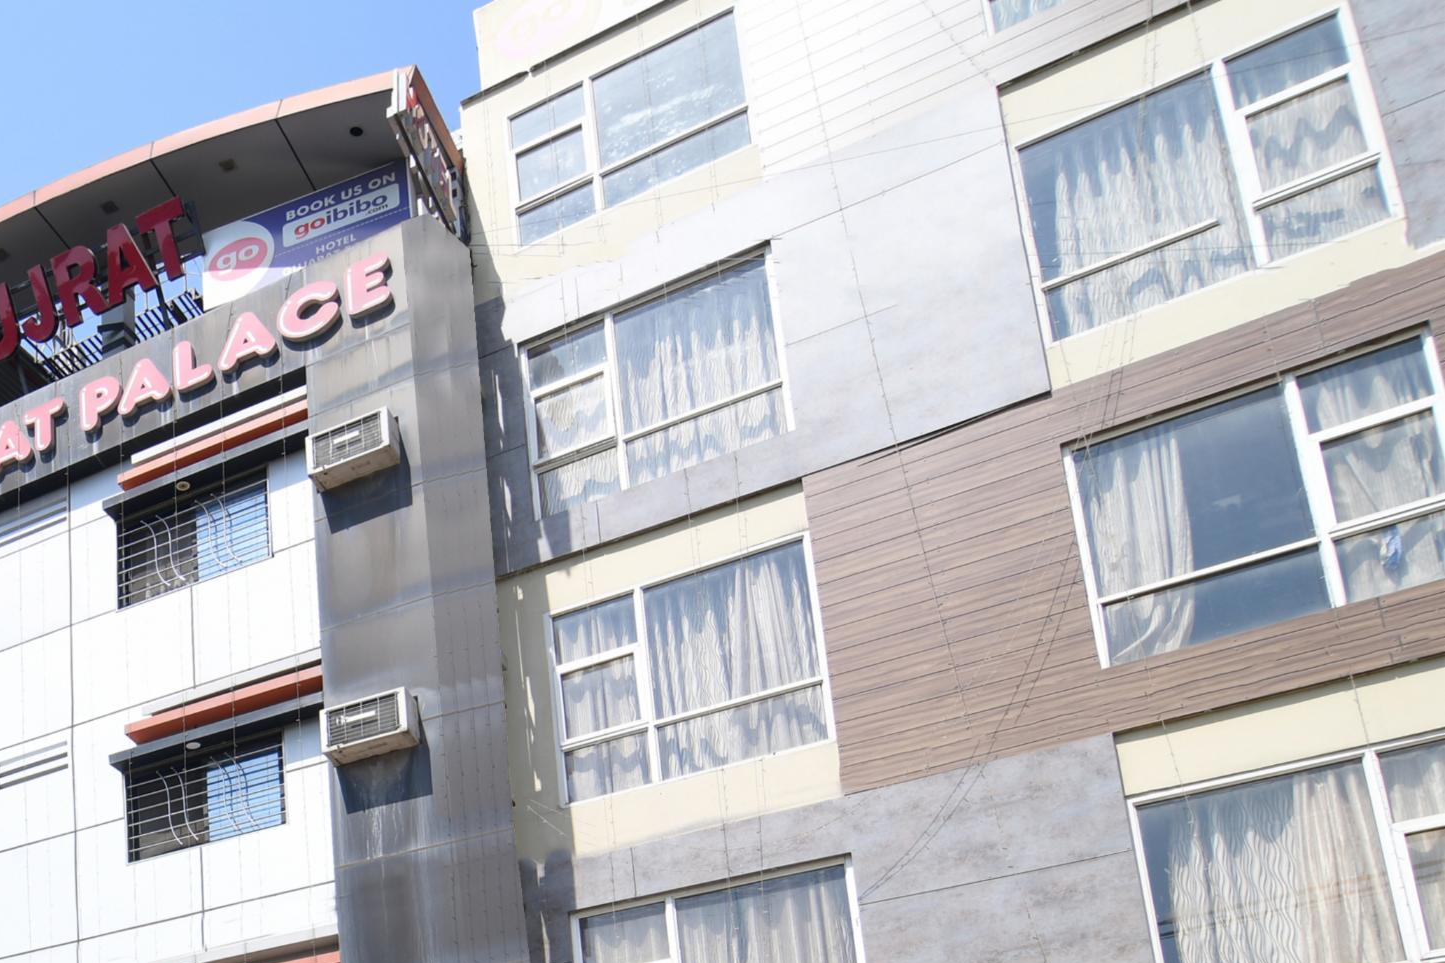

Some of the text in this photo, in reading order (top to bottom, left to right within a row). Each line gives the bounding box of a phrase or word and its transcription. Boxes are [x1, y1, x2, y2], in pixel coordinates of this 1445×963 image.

[285, 171, 397, 222] BOOK US ON
[293, 193, 389, 238] goibibo
[215, 242, 260, 277] go
[315, 233, 357, 254] HOTEL
[78, 250, 393, 433] PALACE
